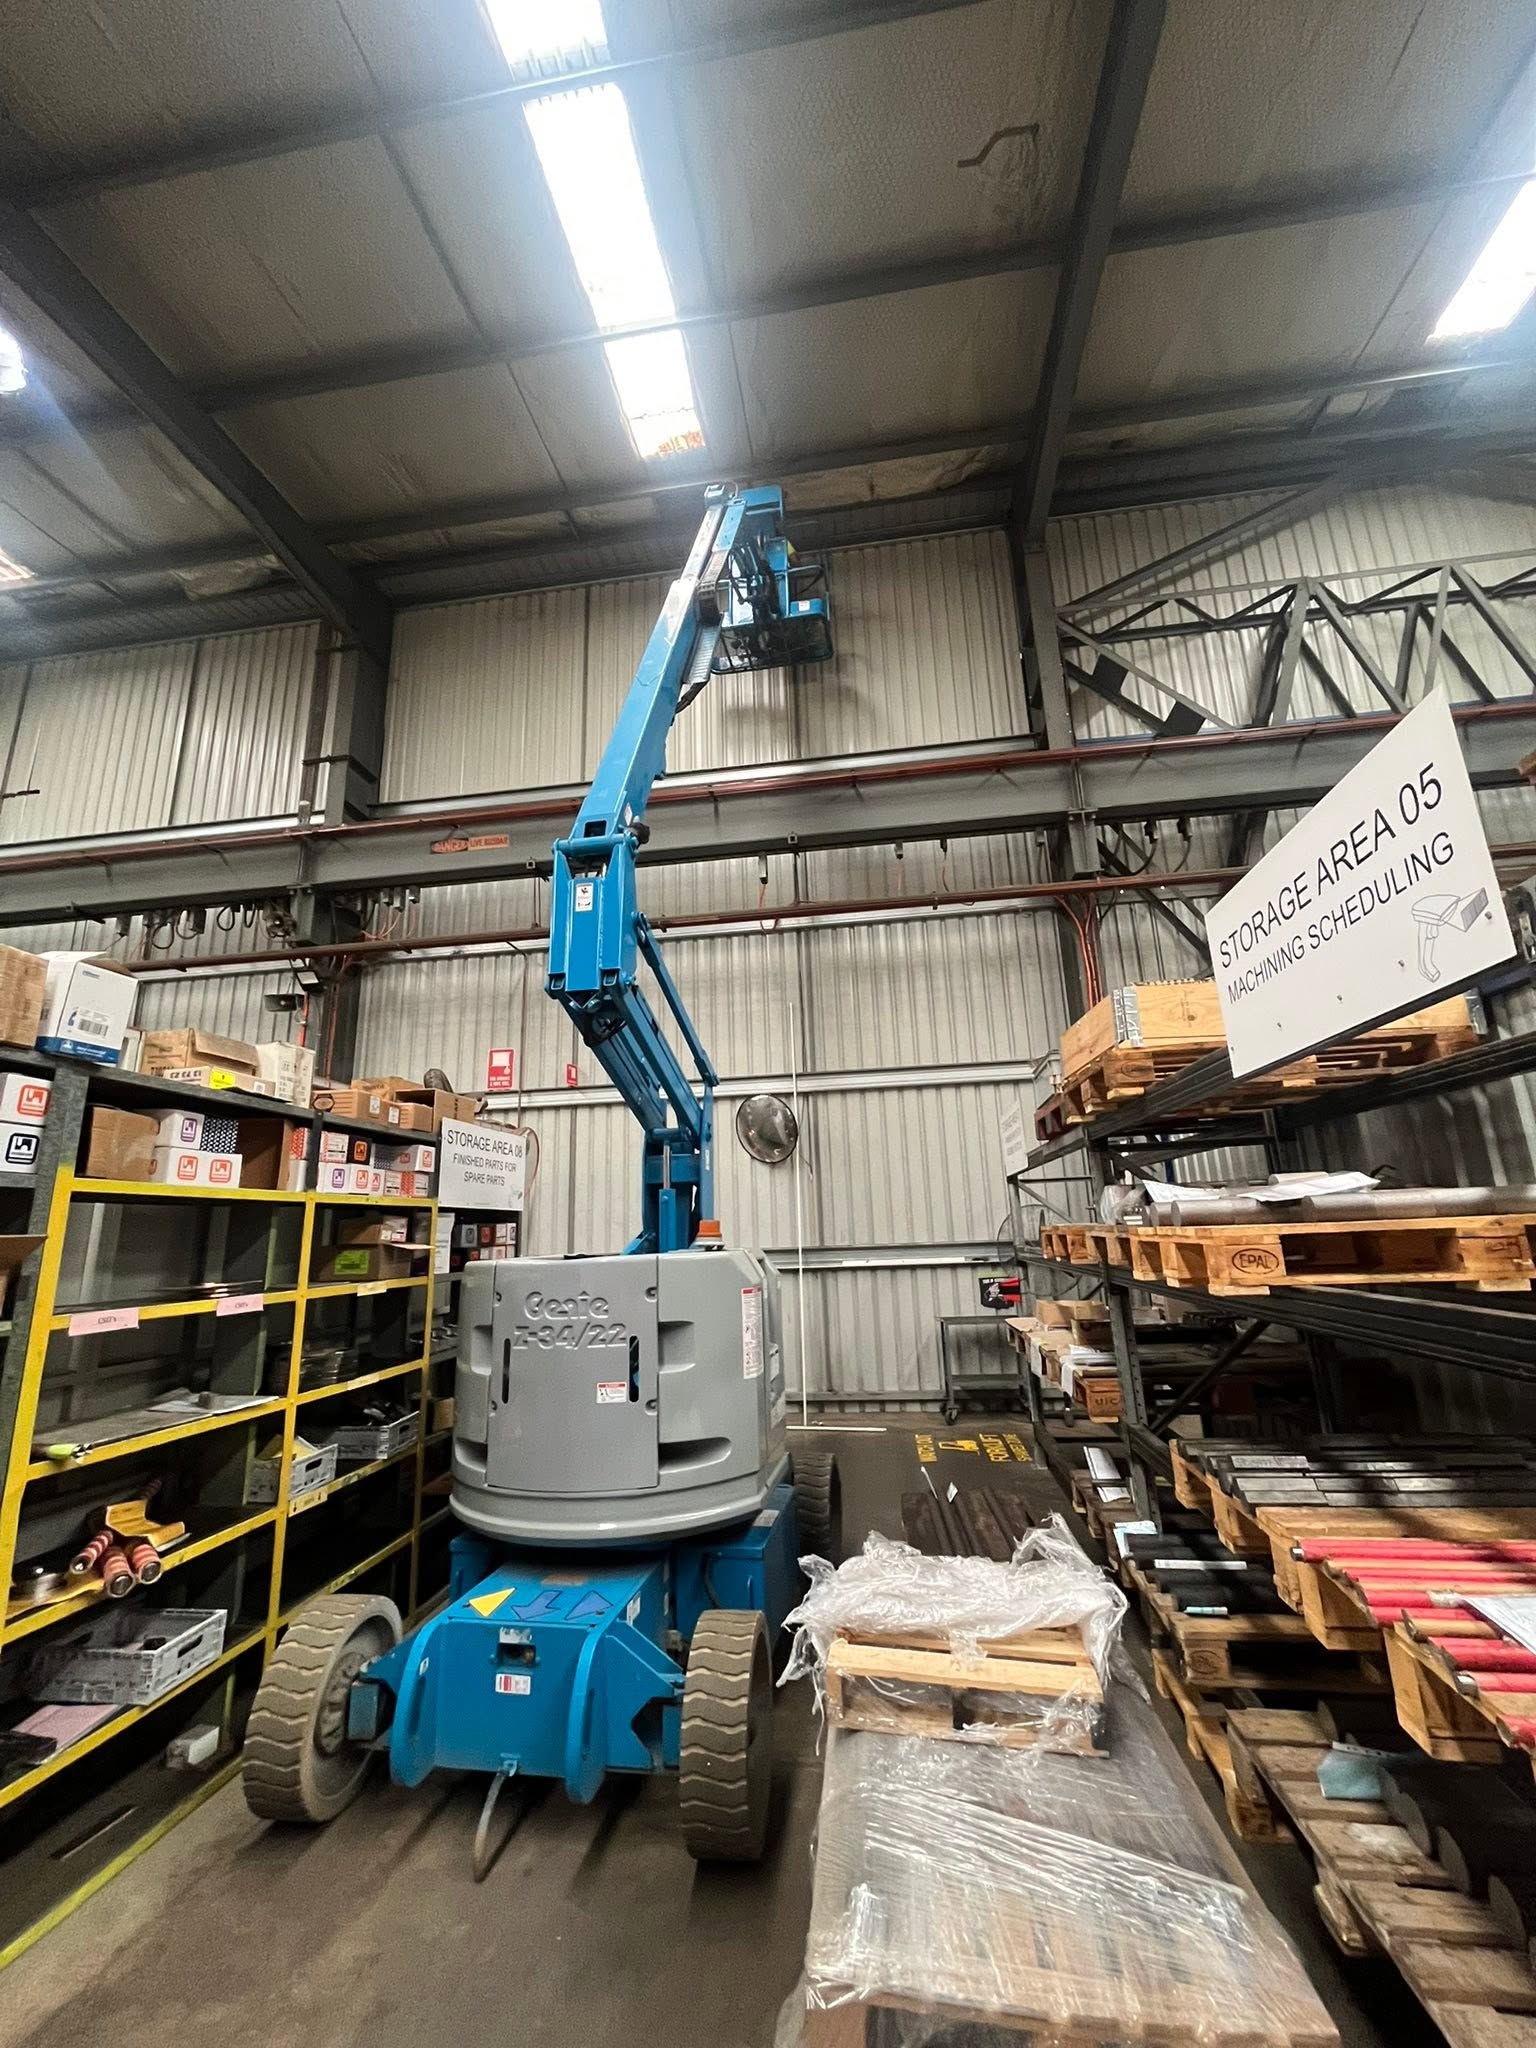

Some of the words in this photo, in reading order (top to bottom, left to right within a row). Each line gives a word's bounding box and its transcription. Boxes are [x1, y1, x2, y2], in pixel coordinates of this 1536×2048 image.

[1218, 871, 1312, 969] STORAGE
[1315, 807, 1397, 896] AREA
[1398, 762, 1443, 826] 05
[1227, 935, 1305, 1005] MACHINING
[1306, 831, 1454, 950] SCHEDULING
[447, 1129, 491, 1152] STORAGE
[492, 1140, 513, 1156] AREA
[453, 1153, 484, 1168] FINISHED
[485, 1158, 504, 1171] PARTS
[505, 1162, 517, 1172] FOR
[464, 1171, 486, 1184] SPARE
[486, 1174, 505, 1186] PARTS
[1239, 1253, 1272, 1270] EPAL
[523, 1290, 609, 1320] Genie
[512, 1321, 627, 1350] Z-34/22
